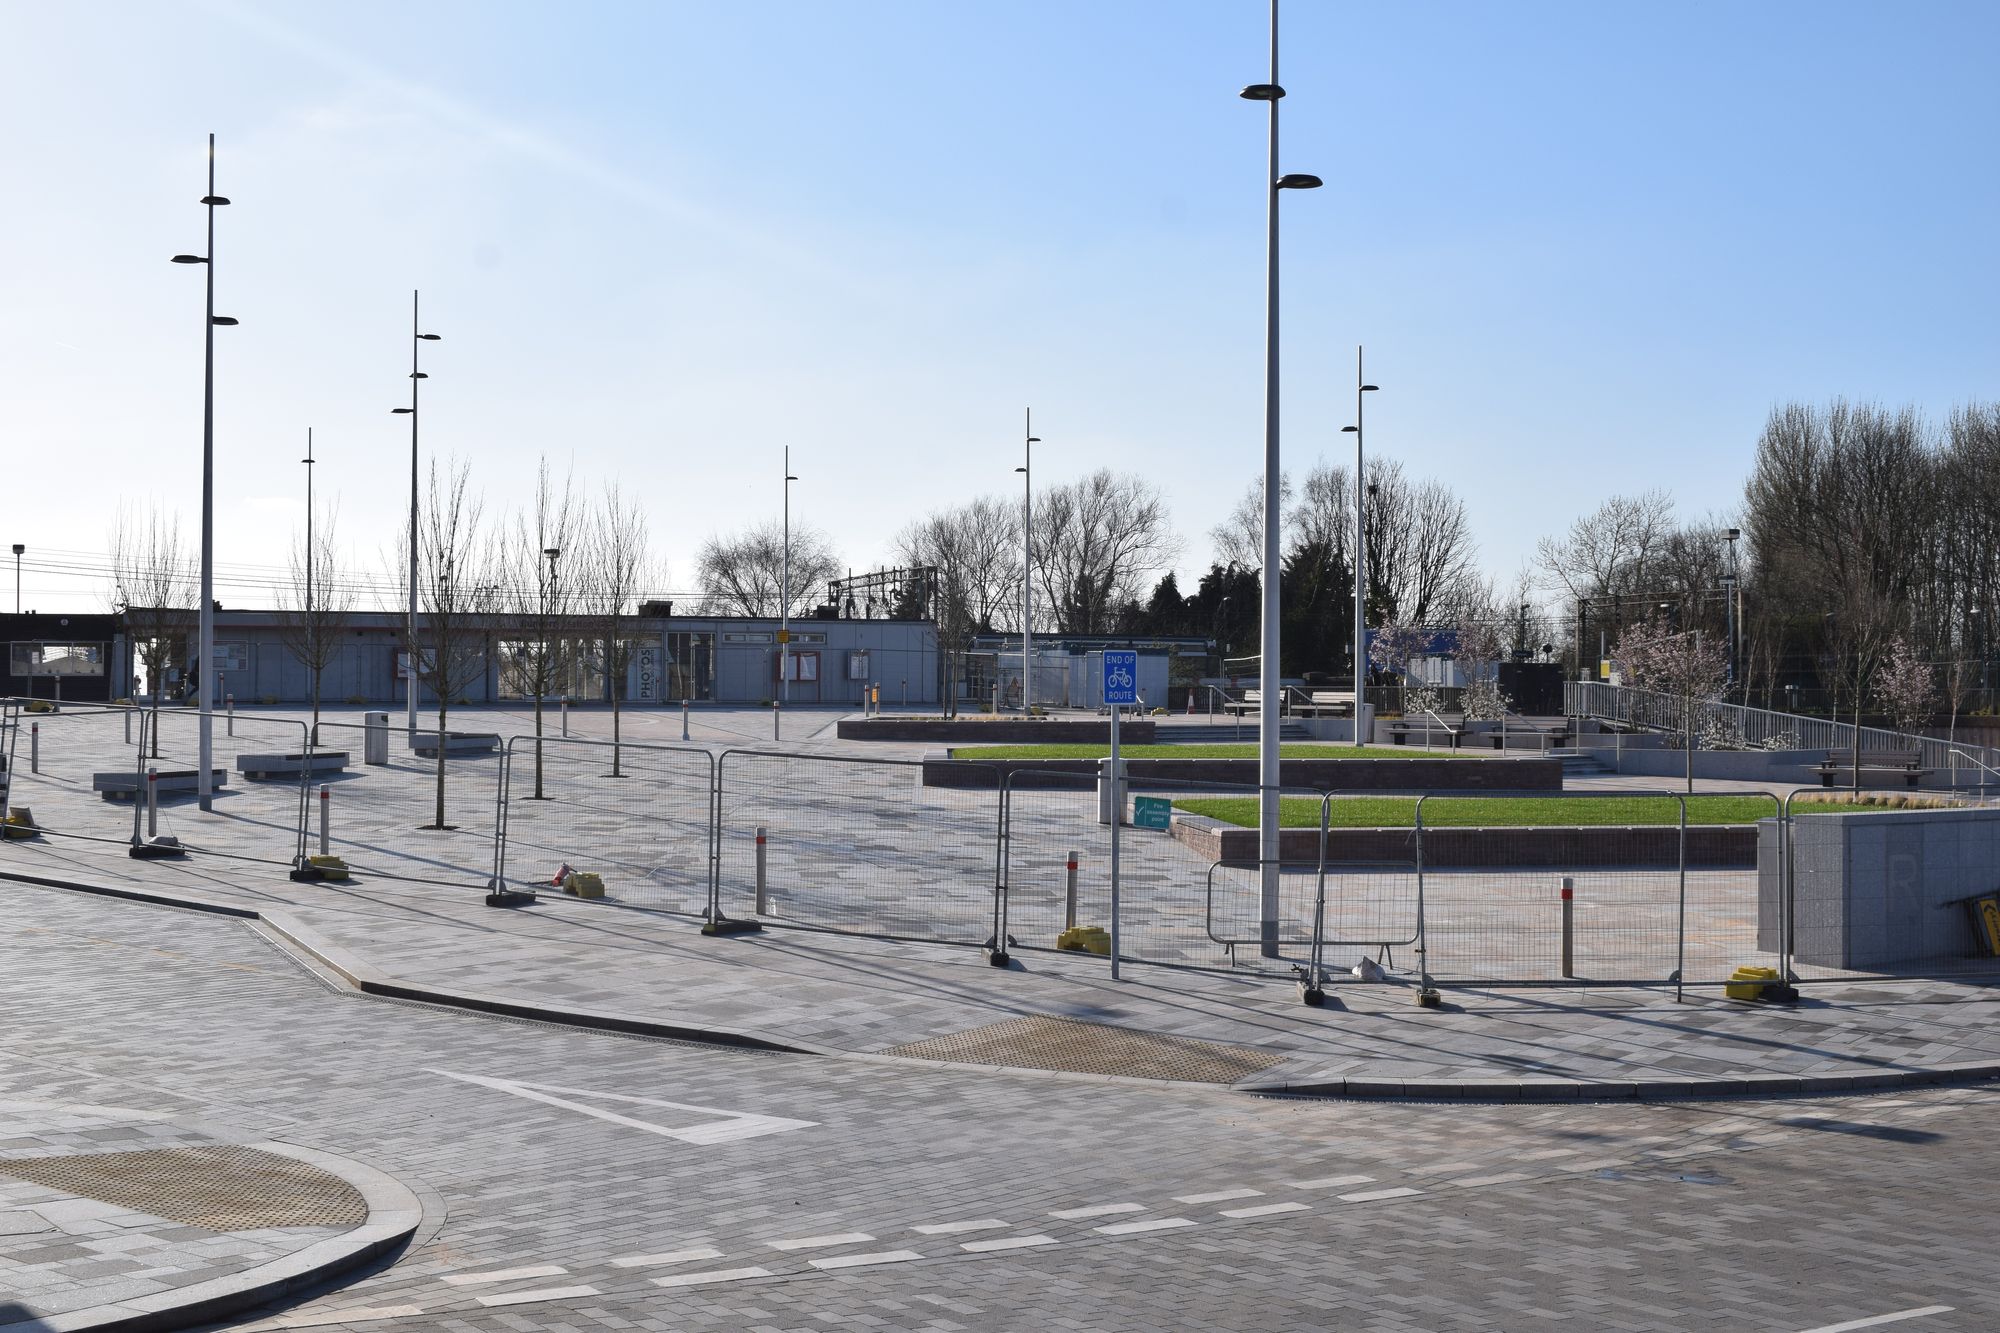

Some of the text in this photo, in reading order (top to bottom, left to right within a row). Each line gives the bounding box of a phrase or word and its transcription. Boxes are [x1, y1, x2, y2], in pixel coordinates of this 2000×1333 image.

[1106, 655, 1135, 664] END OF
[1108, 691, 1132, 700] ROUTE
[1888, 853, 1920, 913] R
